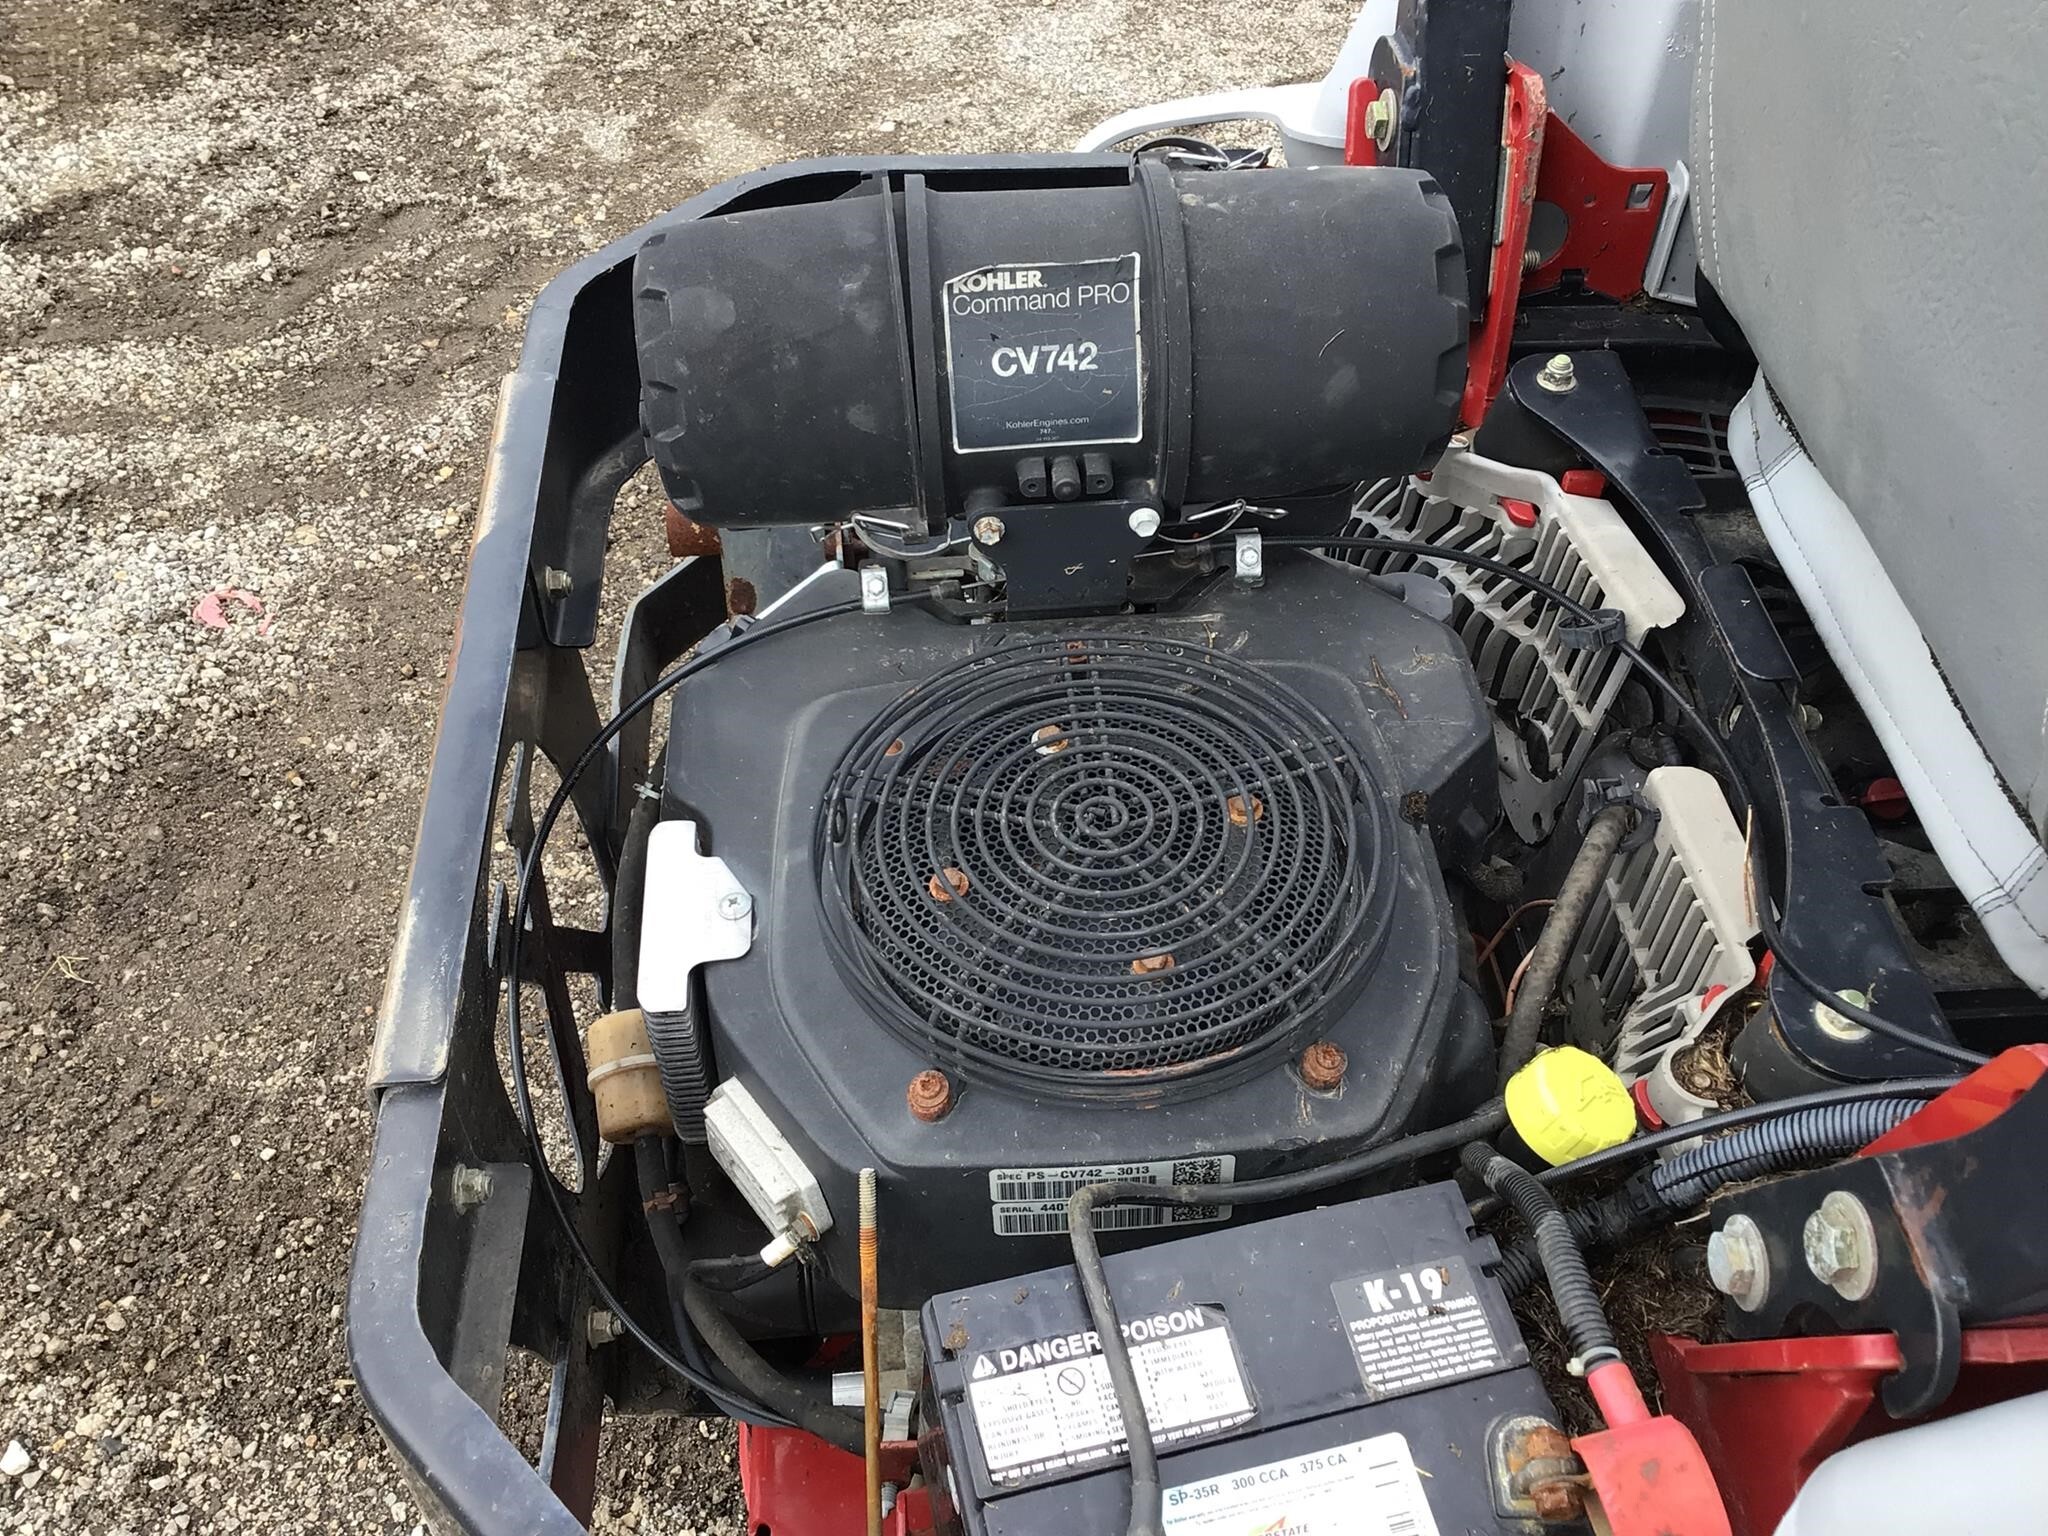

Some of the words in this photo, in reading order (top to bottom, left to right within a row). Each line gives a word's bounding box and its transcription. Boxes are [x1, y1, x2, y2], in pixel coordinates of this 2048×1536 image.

[953, 288, 1070, 315] Command
[1078, 282, 1130, 306] PRO
[991, 341, 1099, 377] CV742
[1005, 416, 1089, 429] KohlerEngines.com
[997, 1173, 1022, 1181] SPEC
[1362, 1267, 1442, 1313] K-19
[1350, 1309, 1417, 1332] PROPOSITION
[1432, 1295, 1477, 1312] ARNING
[999, 1331, 1102, 1371] DANGER
[1168, 1483, 1221, 1507] SP-35R
[1231, 1474, 1256, 1492] 300
[1259, 1466, 1289, 1484] CCA
[1299, 1458, 1324, 1474] 375
[1327, 1452, 1348, 1468] CA
